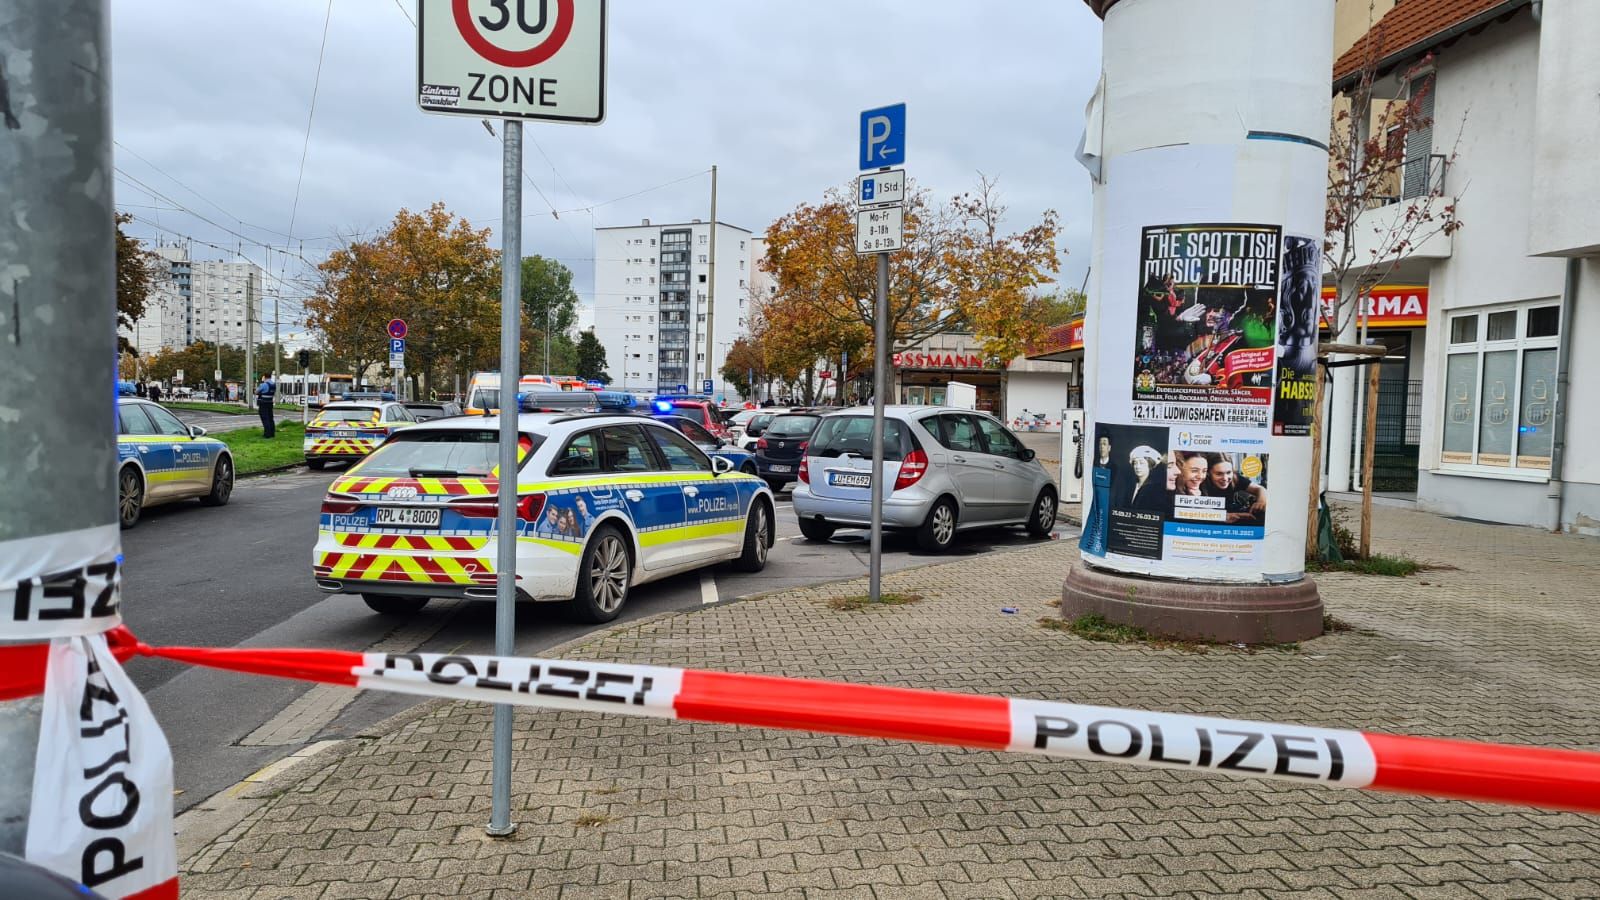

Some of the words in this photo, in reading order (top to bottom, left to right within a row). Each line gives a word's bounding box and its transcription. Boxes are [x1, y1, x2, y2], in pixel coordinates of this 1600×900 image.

[478, 0, 548, 35] 30
[421, 85, 459, 96] Eintracht
[467, 72, 558, 107] ZONE
[421, 95, 459, 106] Frankfurt
[866, 115, 891, 162] P
[869, 211, 890, 222] Mo-Fr
[869, 224, 889, 236] 8-18h
[863, 239, 872, 250] Sa
[875, 237, 895, 249] 8-13h
[1146, 233, 1182, 259] THE
[1186, 232, 1277, 260] SCOTTISH
[1144, 257, 1202, 287] MUSIC
[1207, 257, 1275, 287] PARADE
[1320, 295, 1424, 317] NRMA
[393, 340, 402, 352] P
[892, 352, 983, 369] OSSMANN
[1281, 367, 1295, 379] Die
[1280, 380, 1314, 400] HABSB
[1133, 405, 1159, 419] 12.11.
[1163, 406, 1226, 422] LUDWIGSHAFEN
[1227, 415, 1268, 423] EBERT-HALLE
[1179, 497, 1193, 505] Für
[1194, 497, 1222, 506] Coding
[334, 515, 369, 527] POLIZEI
[376, 507, 396, 523] RPL
[398, 508, 405, 523] 4
[411, 509, 439, 524] 8009
[1176, 526, 1211, 536] Aktionstag
[1033, 714, 1345, 782] POLIZEI
